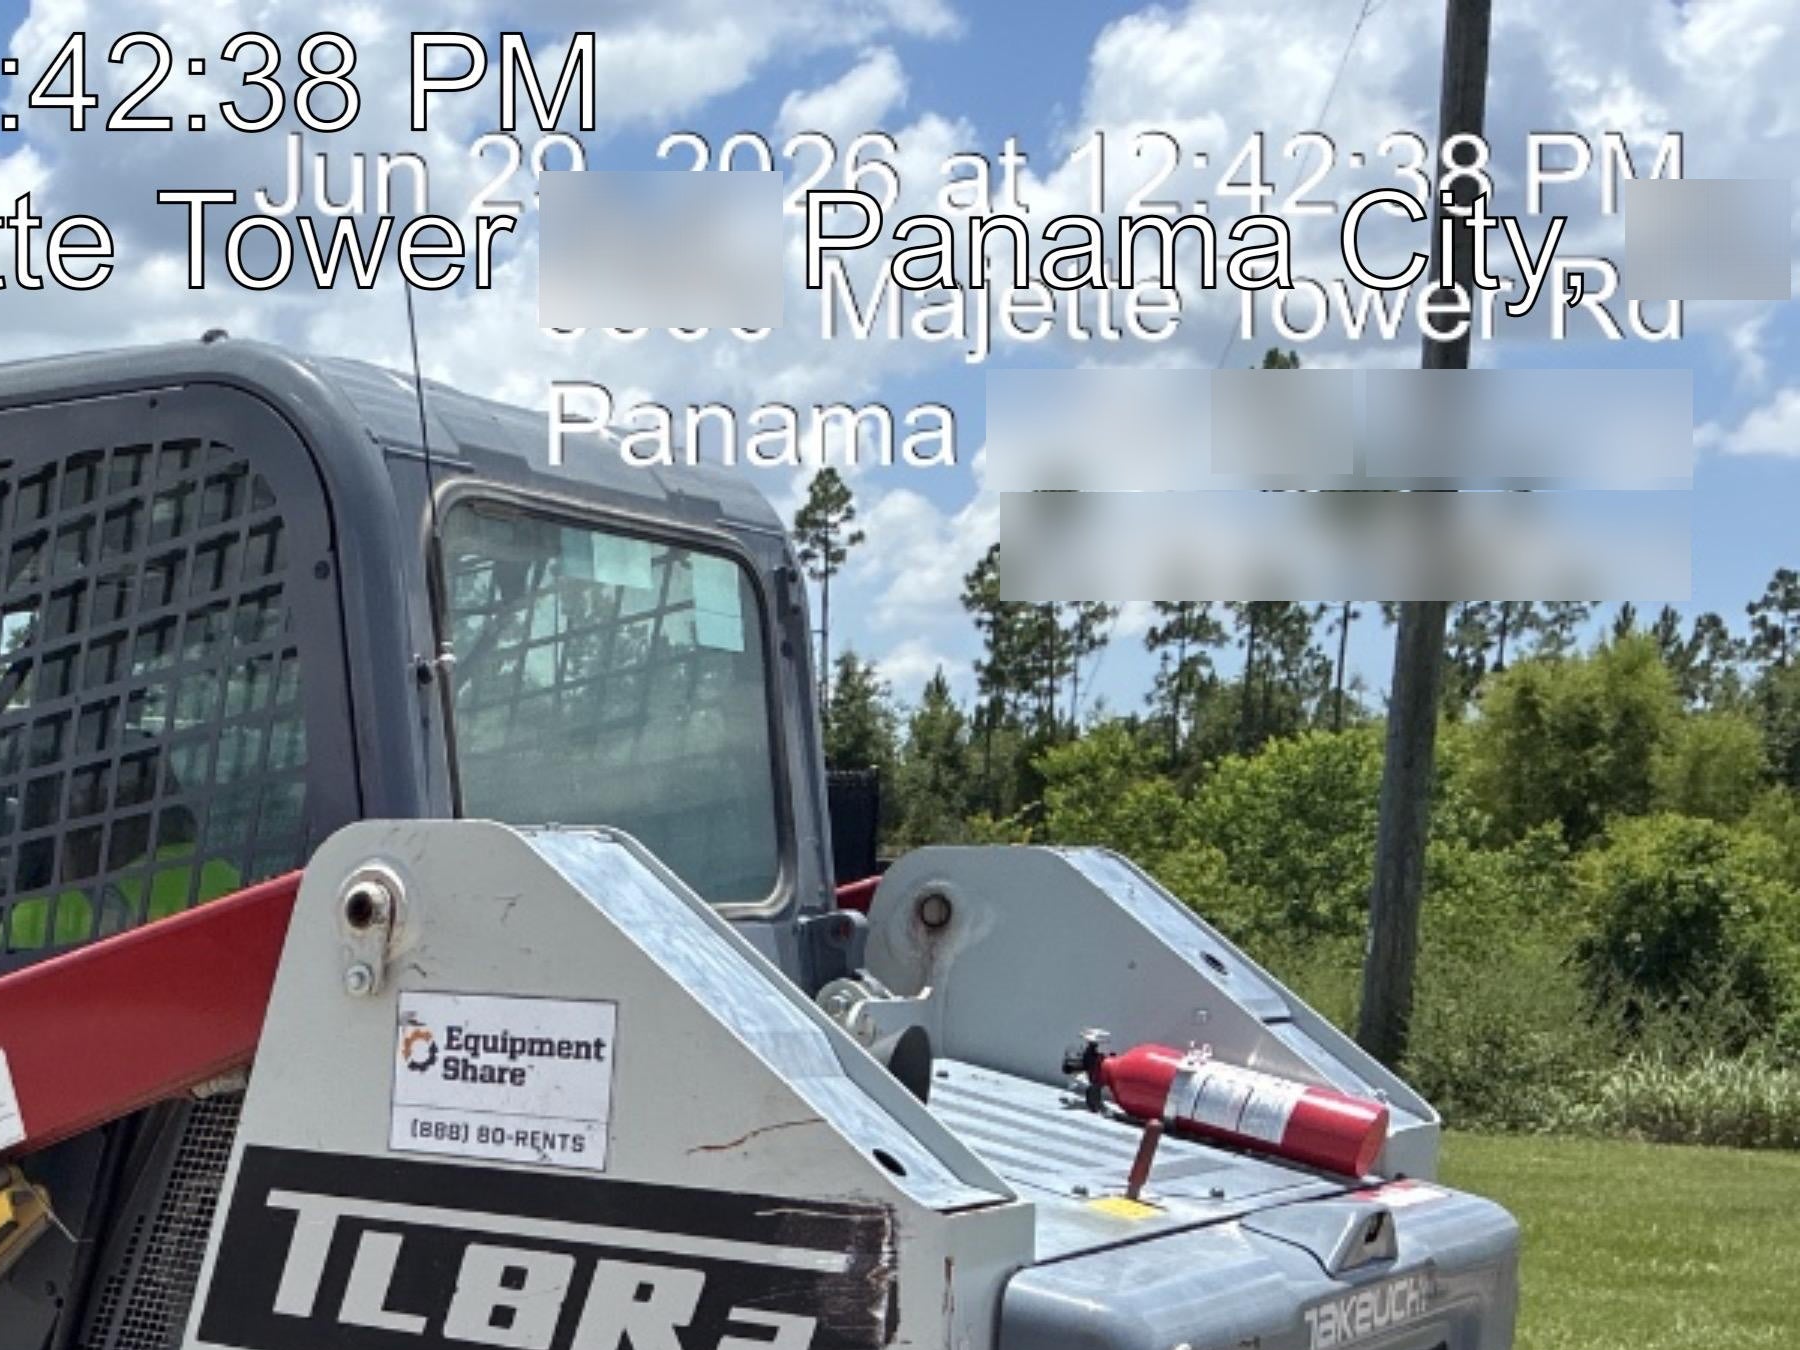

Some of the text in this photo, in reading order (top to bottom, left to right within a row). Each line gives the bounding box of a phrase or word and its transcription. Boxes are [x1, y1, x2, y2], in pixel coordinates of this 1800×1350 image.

[445, 1025, 607, 1062] Equipment
[440, 1057, 527, 1087] Share
[410, 1117, 586, 1153] (888) 80-RENTS
